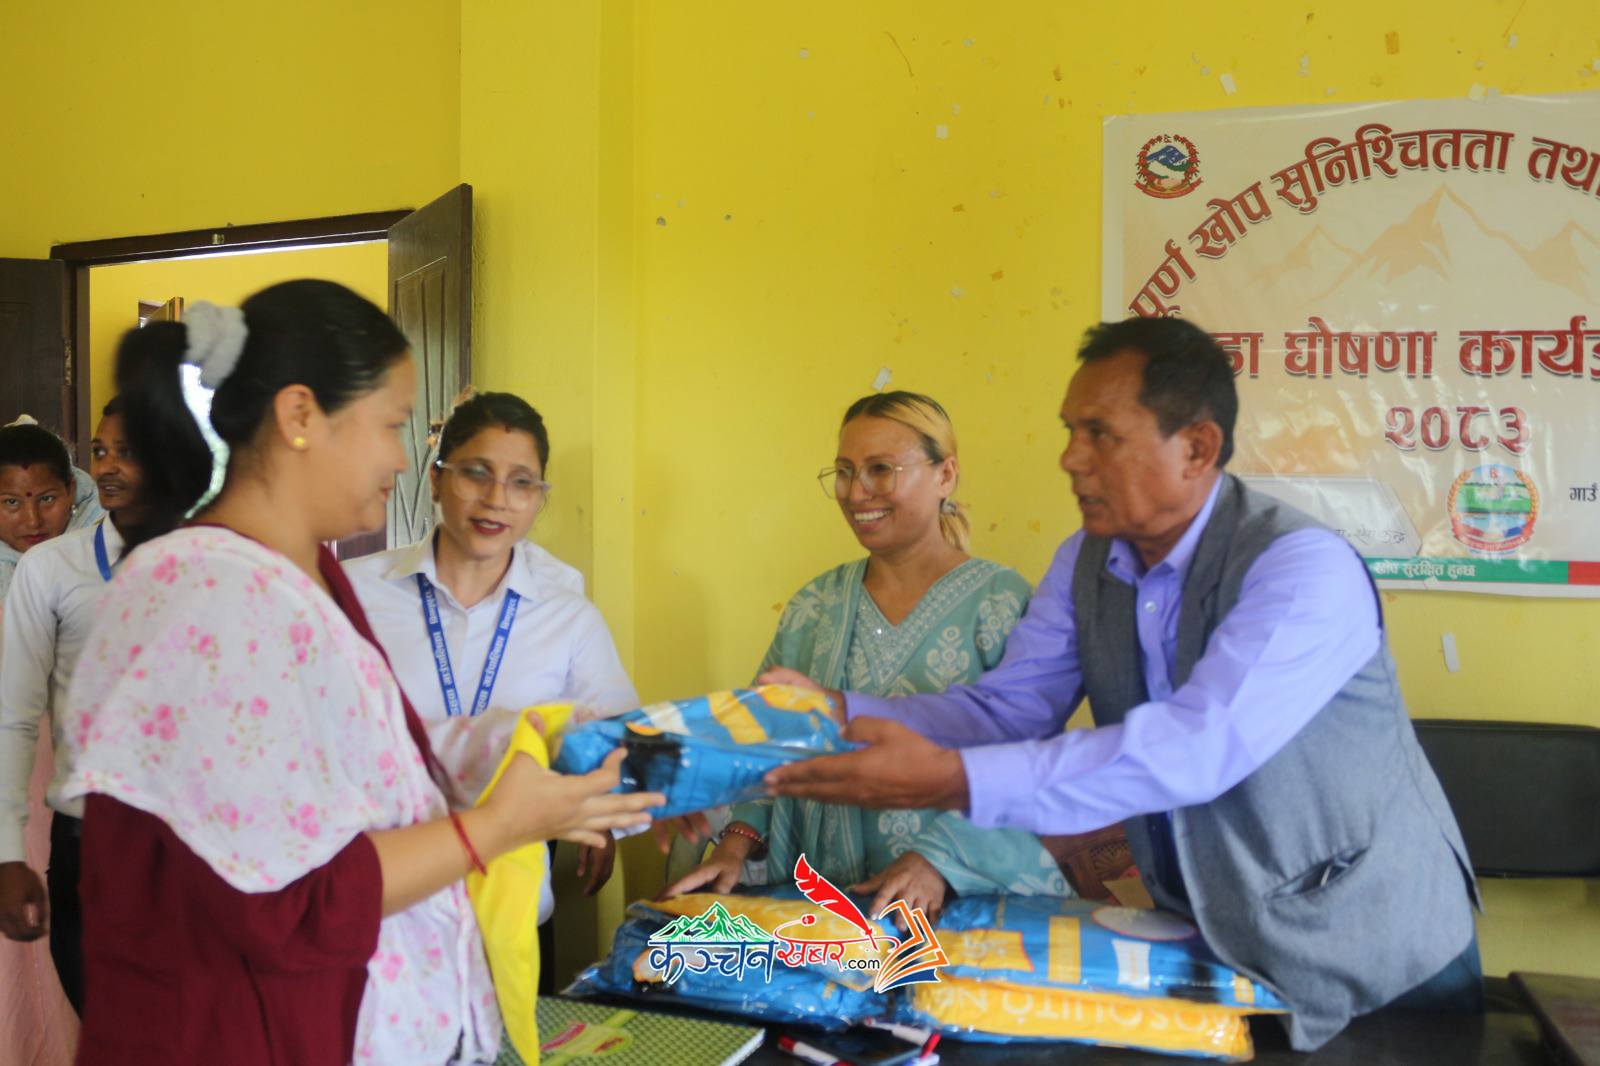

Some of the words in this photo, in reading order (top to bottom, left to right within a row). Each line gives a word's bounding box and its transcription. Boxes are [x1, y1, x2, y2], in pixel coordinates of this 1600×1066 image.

[1190, 181, 1272, 258] खोप
[1271, 123, 1515, 214] सुनिश्चितता
[1285, 316, 1437, 378] घोषणा
[1459, 315, 1600, 380] कार्य
[1385, 405, 1530, 455] २०८३
[1403, 561, 1444, 578] सुरक्षित
